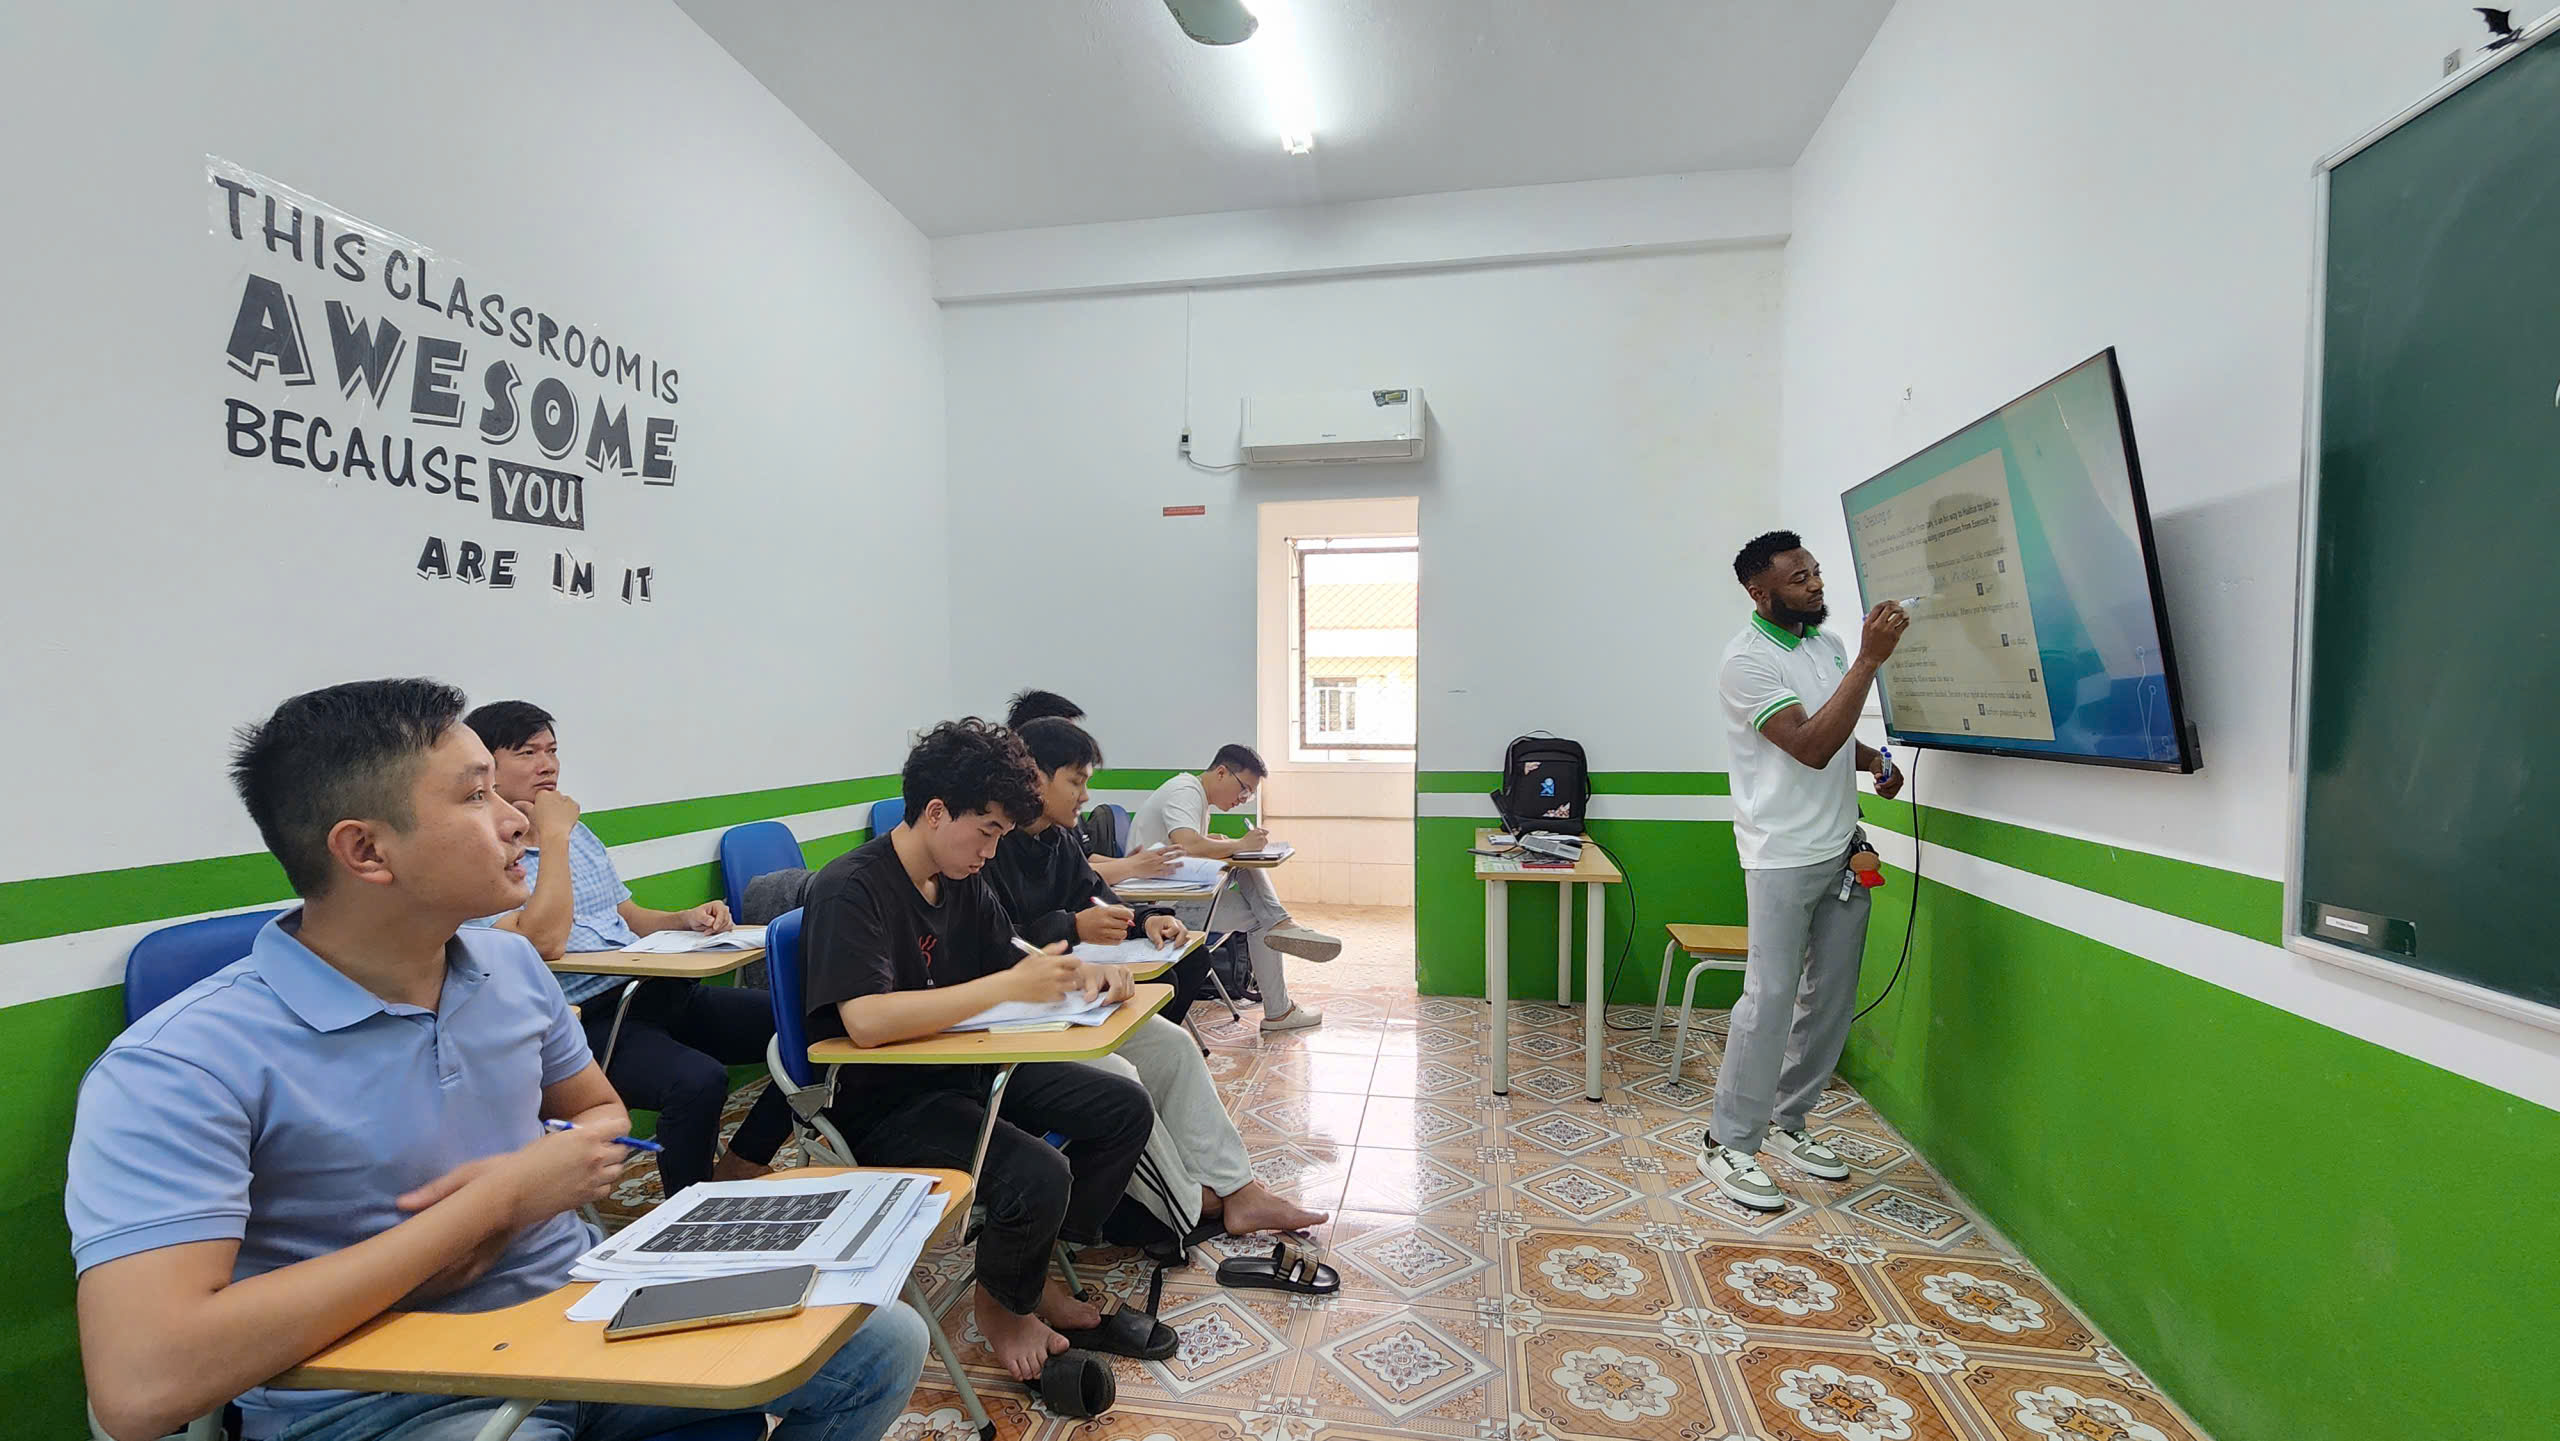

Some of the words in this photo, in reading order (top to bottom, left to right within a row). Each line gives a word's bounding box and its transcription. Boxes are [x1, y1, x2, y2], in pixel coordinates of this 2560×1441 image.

[214, 174, 366, 283] THIS
[383, 249, 642, 391] CLASSROOM
[651, 359, 679, 404] IS
[224, 397, 480, 504] BECAUSE
[495, 466, 579, 523] YOU
[225, 273, 678, 487] AWESOME
[416, 535, 519, 589] ARE
[551, 548, 595, 599] IN
[620, 565, 654, 605] IT
